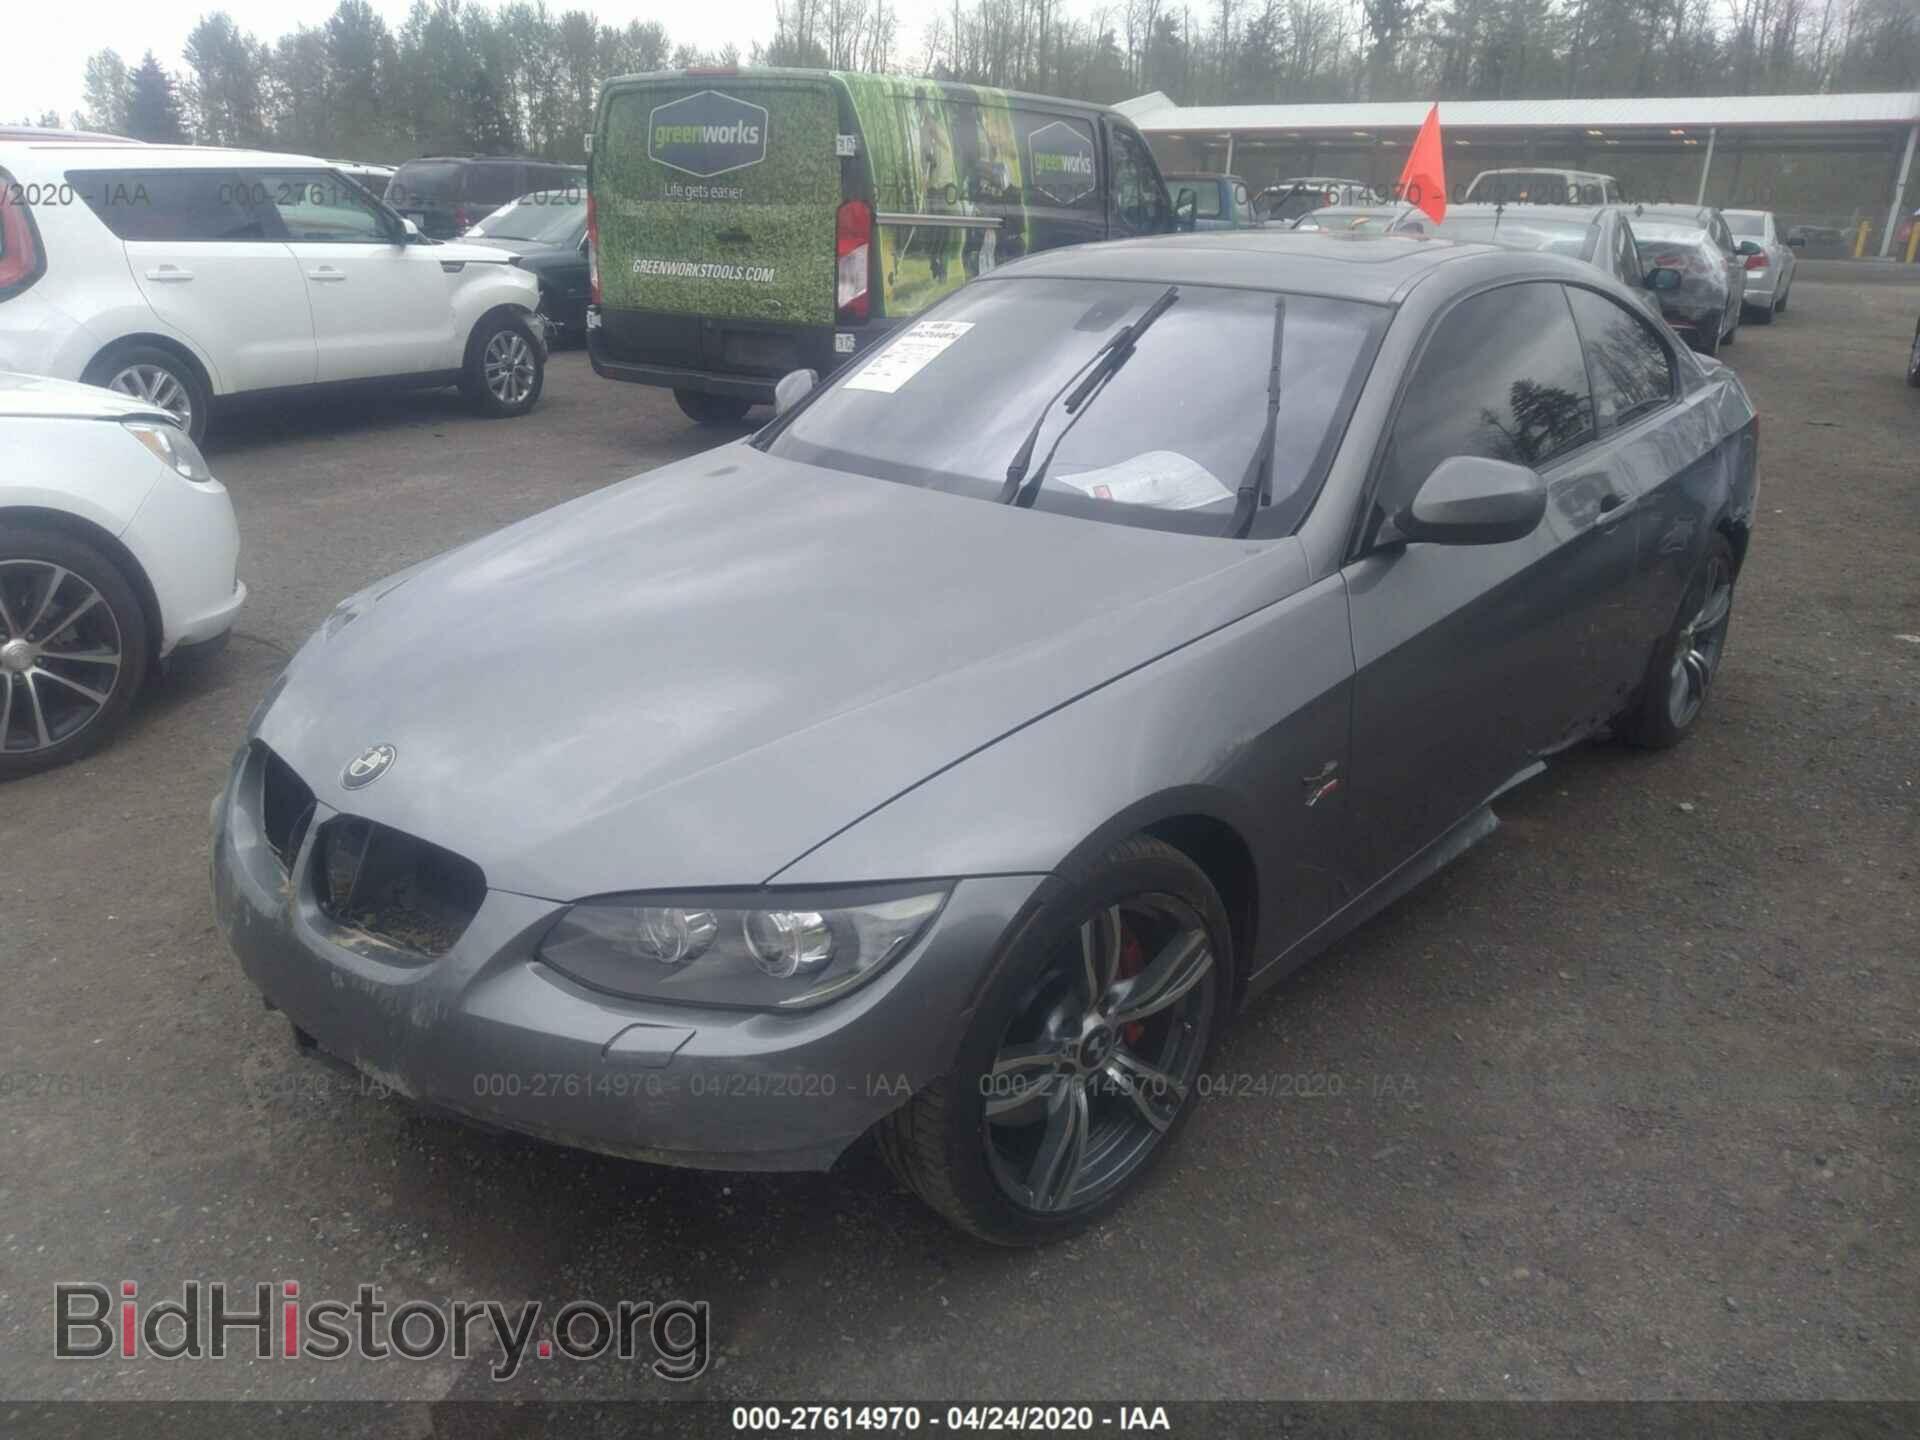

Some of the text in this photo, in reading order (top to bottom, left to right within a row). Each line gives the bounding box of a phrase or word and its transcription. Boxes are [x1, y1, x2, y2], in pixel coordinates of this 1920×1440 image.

[655, 120, 759, 148] greenworks
[1034, 151, 1091, 175] greenworks
[665, 182, 744, 200] Life gets easier
[633, 259, 775, 282] GREENWORKSTOOLS.COM
